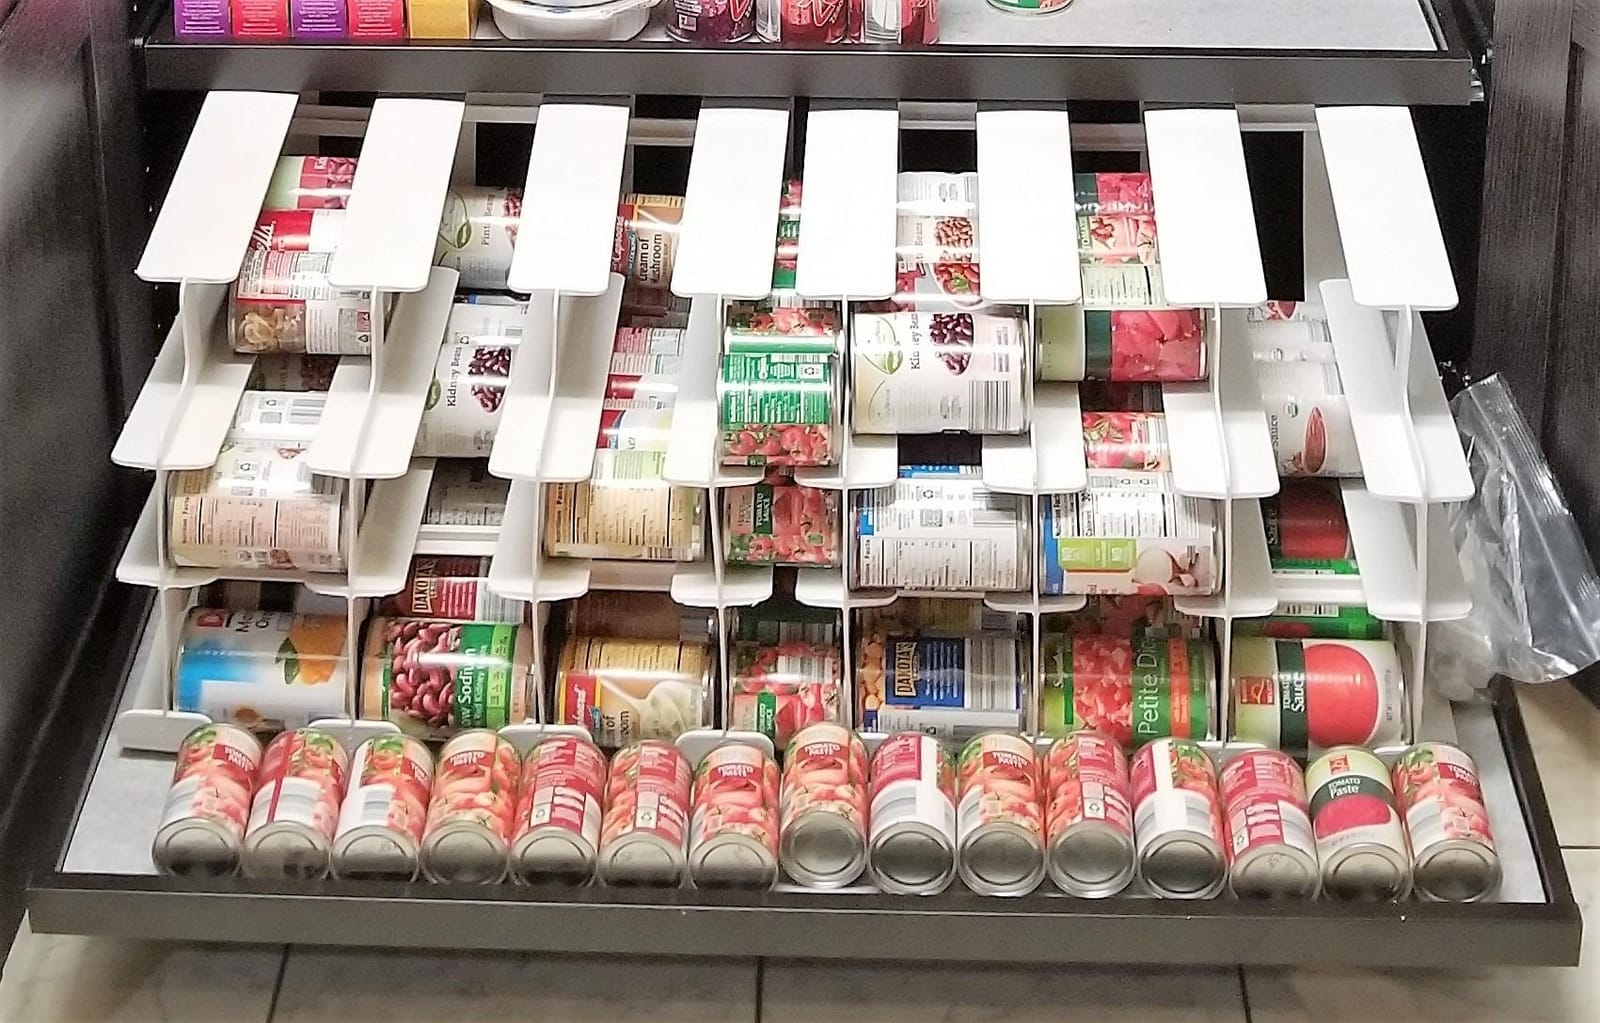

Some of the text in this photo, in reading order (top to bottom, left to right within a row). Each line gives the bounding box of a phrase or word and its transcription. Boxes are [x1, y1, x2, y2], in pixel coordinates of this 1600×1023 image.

[1292, 672, 1305, 713] Sauce
[1137, 673, 1160, 735] Petite
[804, 743, 841, 753] TOMATO
[992, 752, 1029, 766] TOMATO
[717, 764, 754, 774] TOMATO
[1328, 777, 1361, 790] TOMATO
[1329, 785, 1360, 800] Paste
